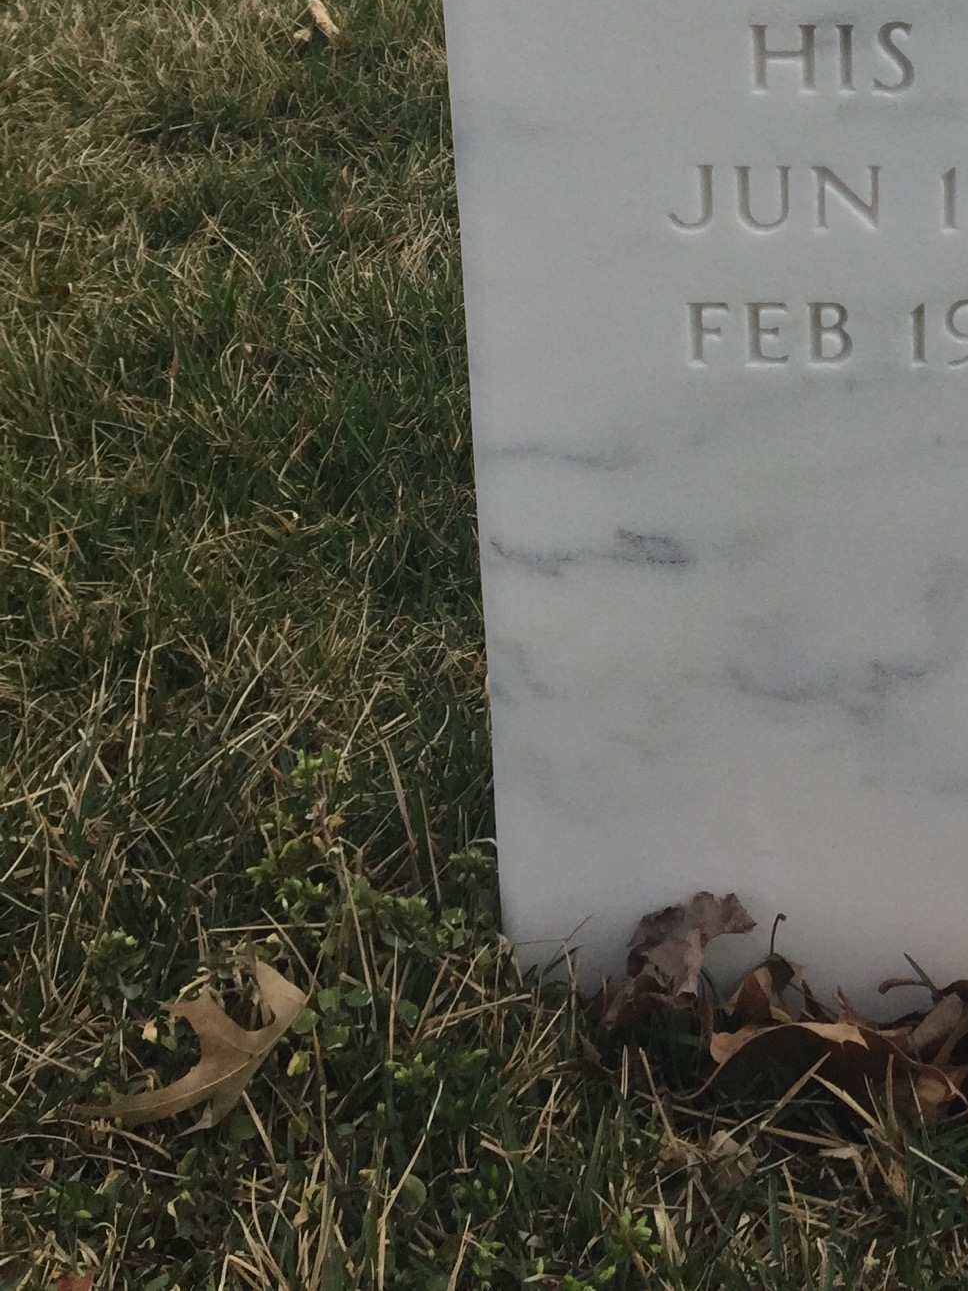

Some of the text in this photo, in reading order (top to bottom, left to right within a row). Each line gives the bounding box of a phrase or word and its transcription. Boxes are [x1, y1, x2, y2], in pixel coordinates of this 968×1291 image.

[749, 21, 917, 95] HIS
[667, 164, 883, 234] JUN
[686, 300, 854, 368] FEB
